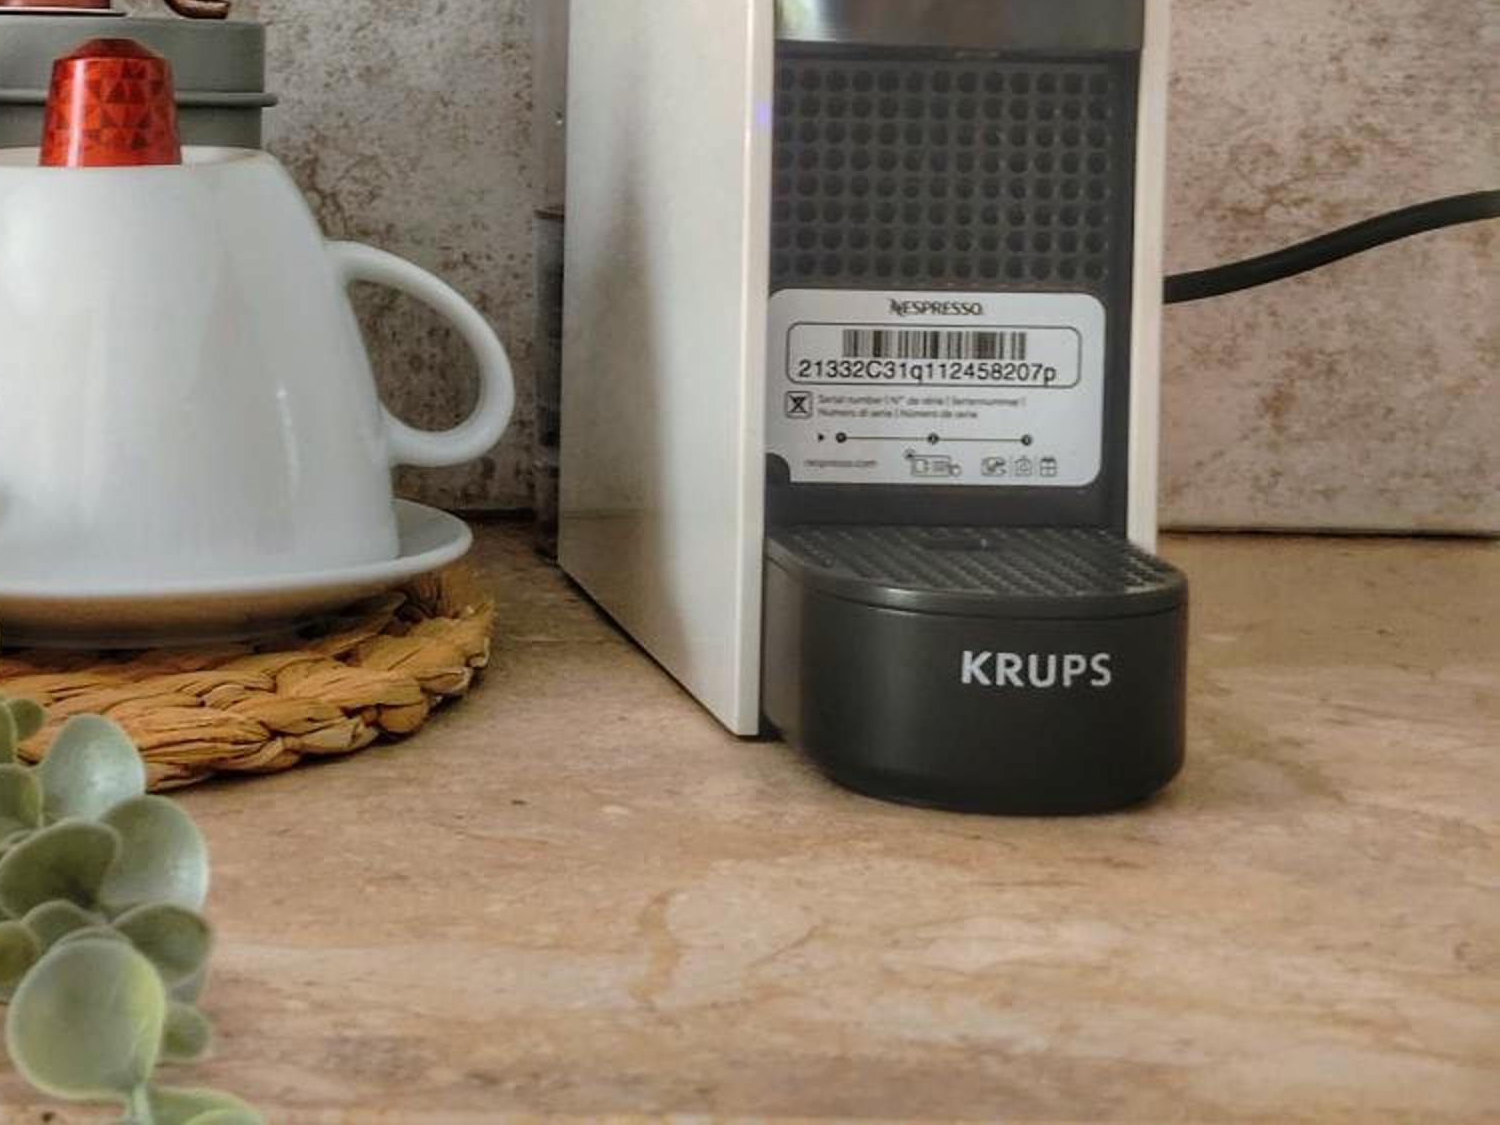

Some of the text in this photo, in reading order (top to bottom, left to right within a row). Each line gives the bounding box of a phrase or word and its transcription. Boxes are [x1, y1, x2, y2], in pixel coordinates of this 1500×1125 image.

[890, 299, 984, 316] NESPRESSO
[799, 359, 1057, 386] 21332C31q112458207p
[961, 650, 1112, 687] KRUPS
